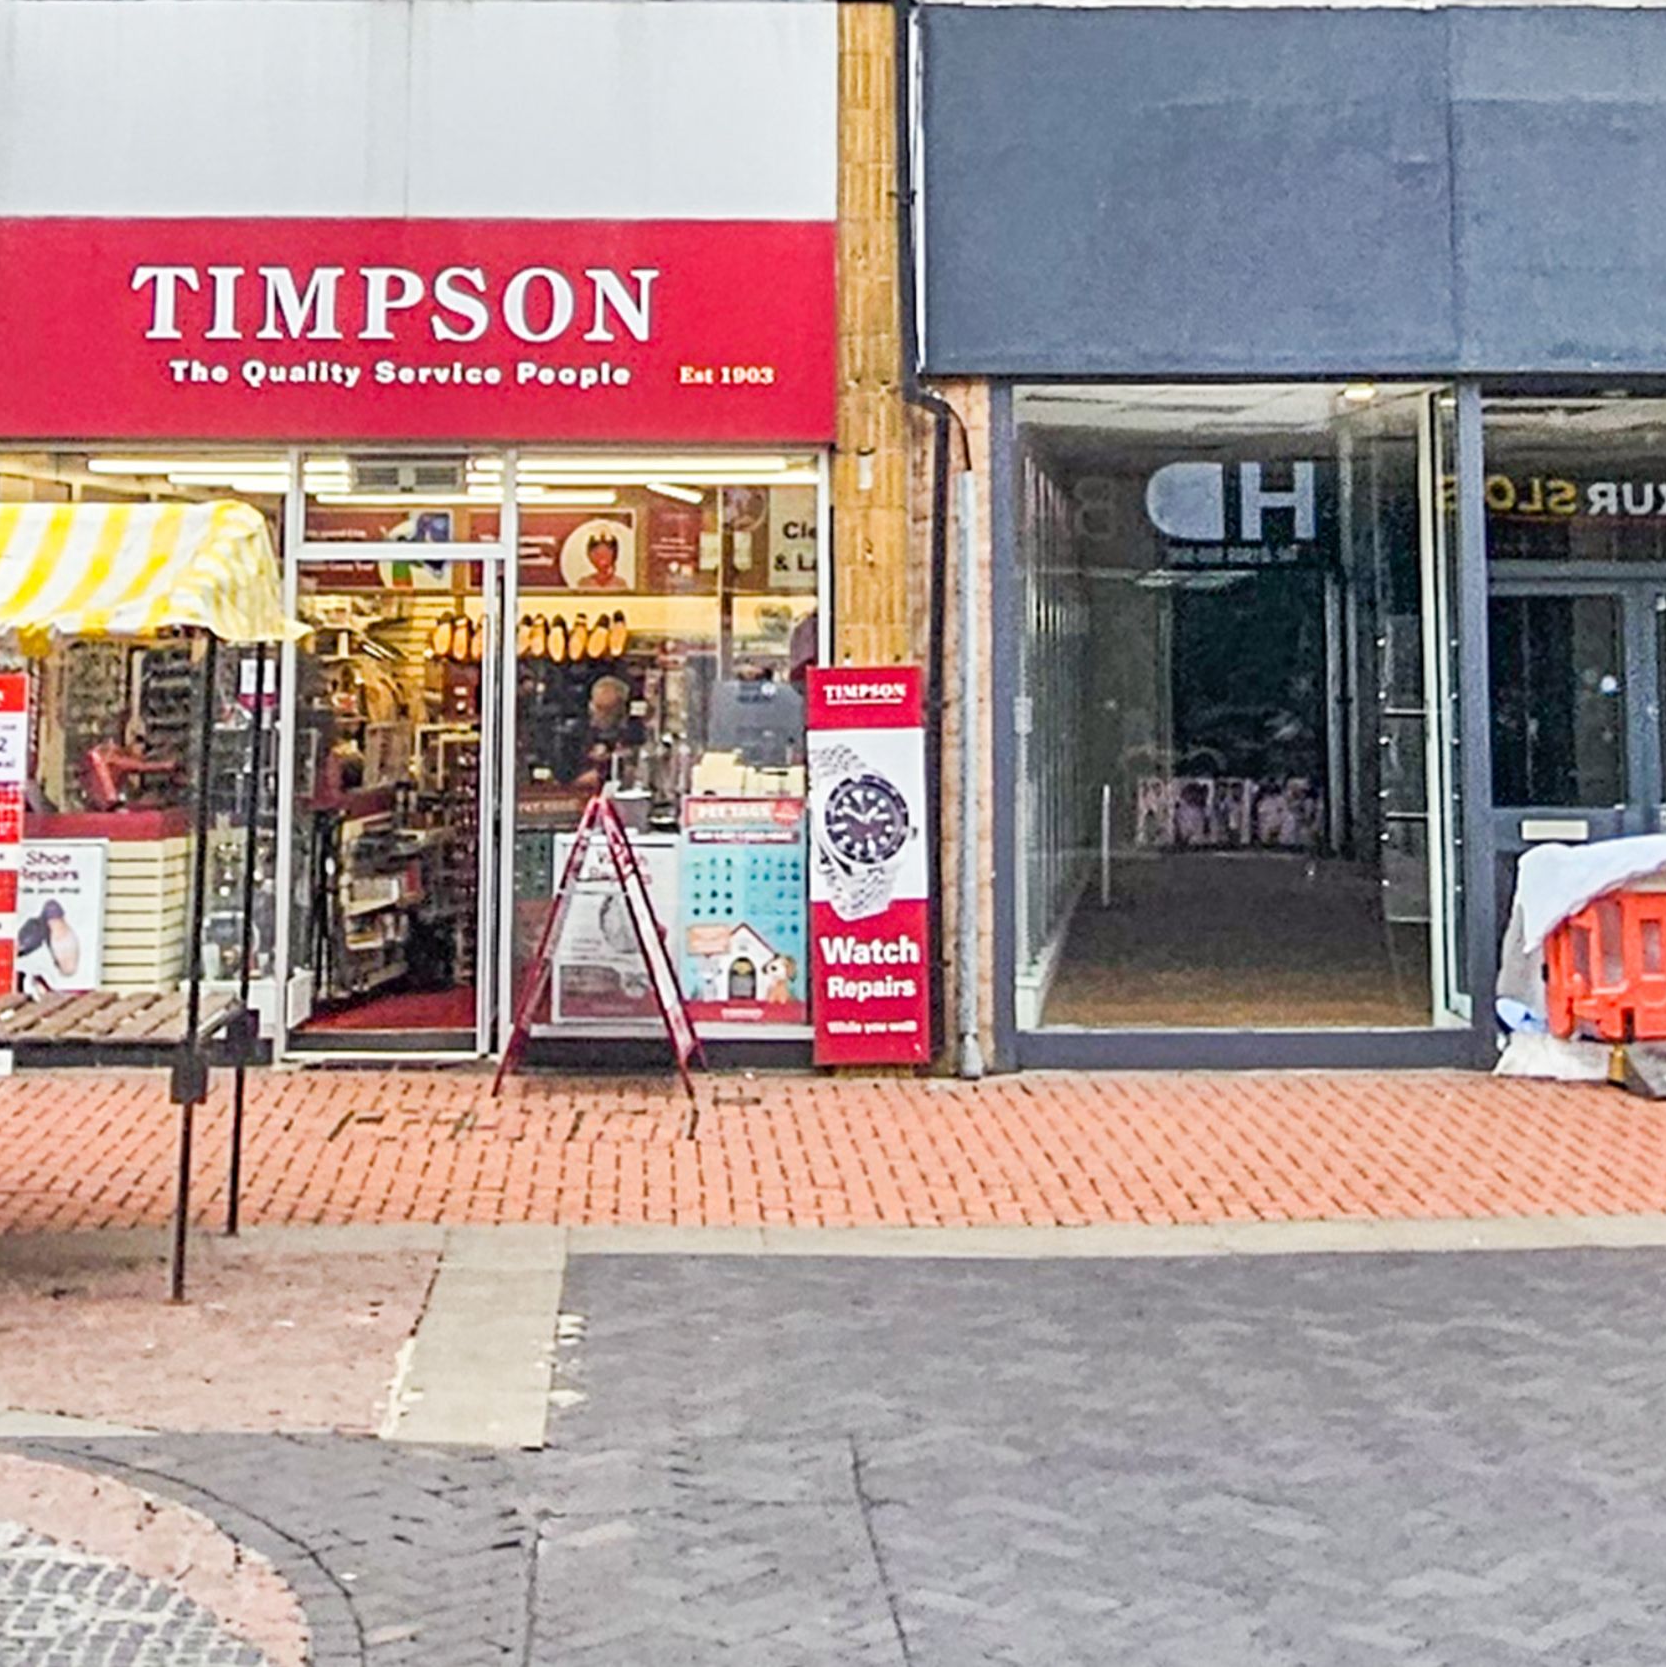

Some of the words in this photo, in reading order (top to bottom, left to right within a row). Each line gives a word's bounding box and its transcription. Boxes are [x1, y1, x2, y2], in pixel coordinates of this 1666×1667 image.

[130, 265, 660, 343] TIMPSON
[169, 359, 229, 384] The
[241, 359, 361, 389] Quality
[375, 360, 502, 386] Service
[517, 361, 631, 390] People
[679, 365, 714, 385] Est
[720, 365, 775, 385] 1903
[822, 682, 907, 700] TIMPSON
[25, 849, 72, 866] Shoe
[818, 934, 921, 965] Watch
[826, 974, 917, 1004] Repairs
